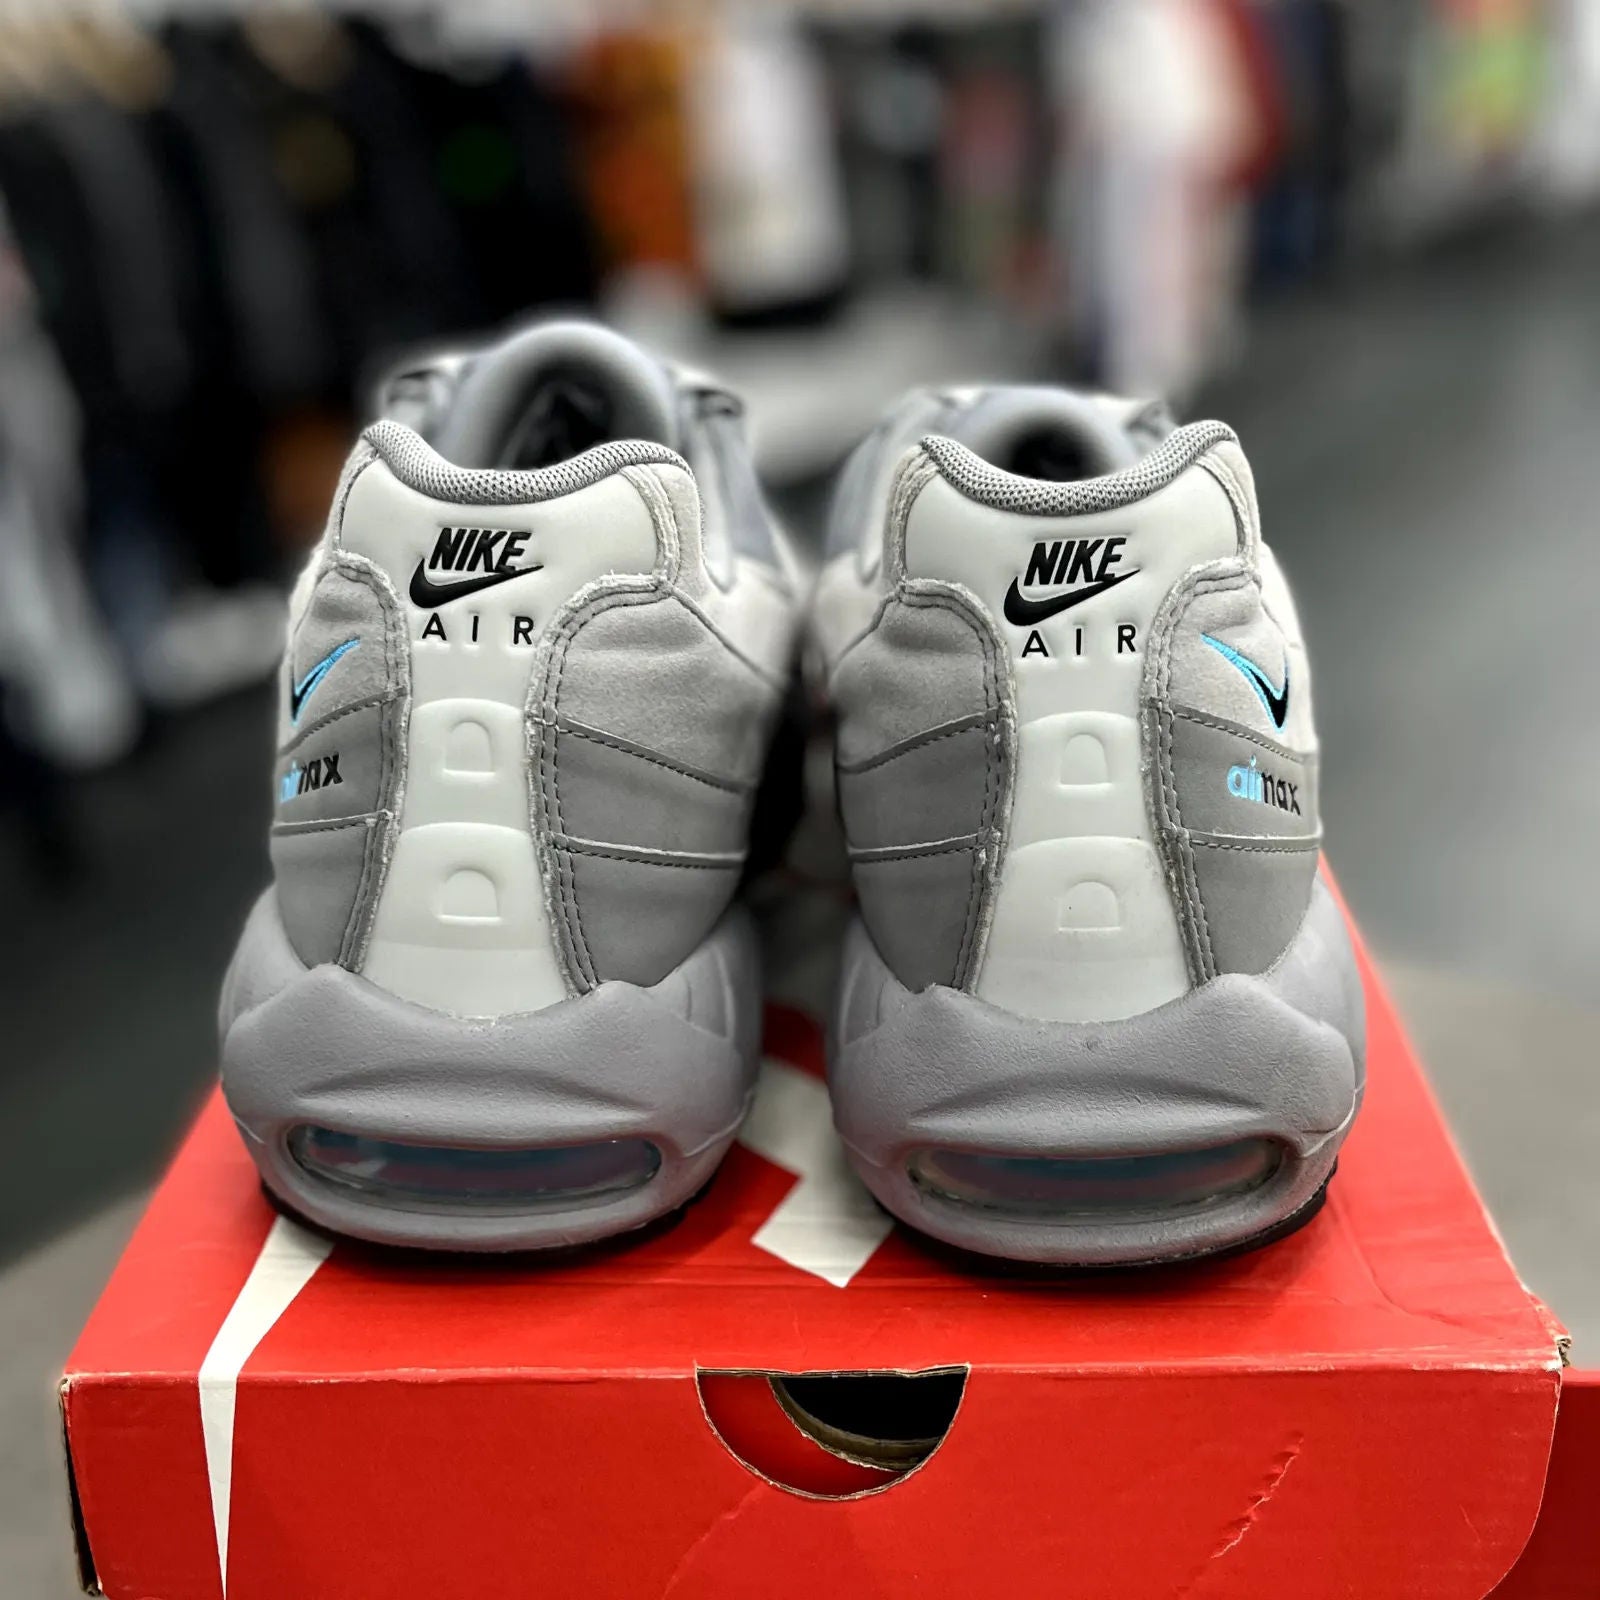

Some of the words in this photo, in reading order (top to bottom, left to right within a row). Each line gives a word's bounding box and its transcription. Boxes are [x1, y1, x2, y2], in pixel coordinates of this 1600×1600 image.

[429, 527, 533, 574] NIKE
[1023, 537, 1127, 586] NIKE
[422, 612, 534, 645] AIR
[1021, 624, 1137, 658] AIR
